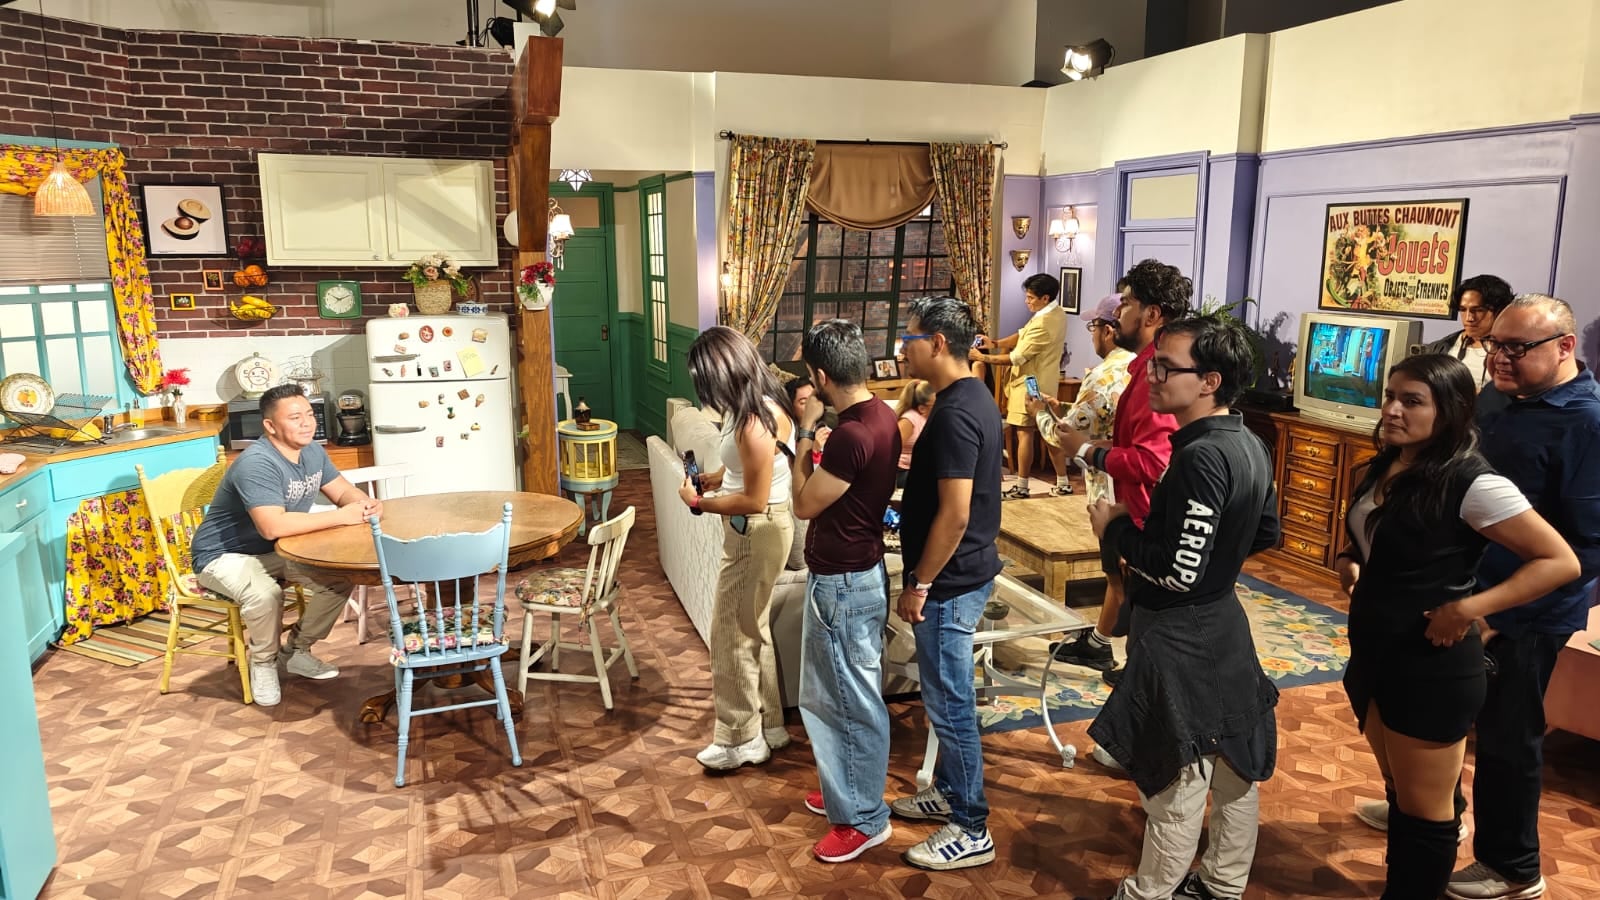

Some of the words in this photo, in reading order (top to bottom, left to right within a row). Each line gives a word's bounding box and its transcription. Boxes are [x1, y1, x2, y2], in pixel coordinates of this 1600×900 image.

[1330, 212, 1349, 232] AUX
[1354, 208, 1389, 226] BUTTES
[1395, 207, 1459, 229] CHAUMONT
[1377, 232, 1449, 275] Jouets
